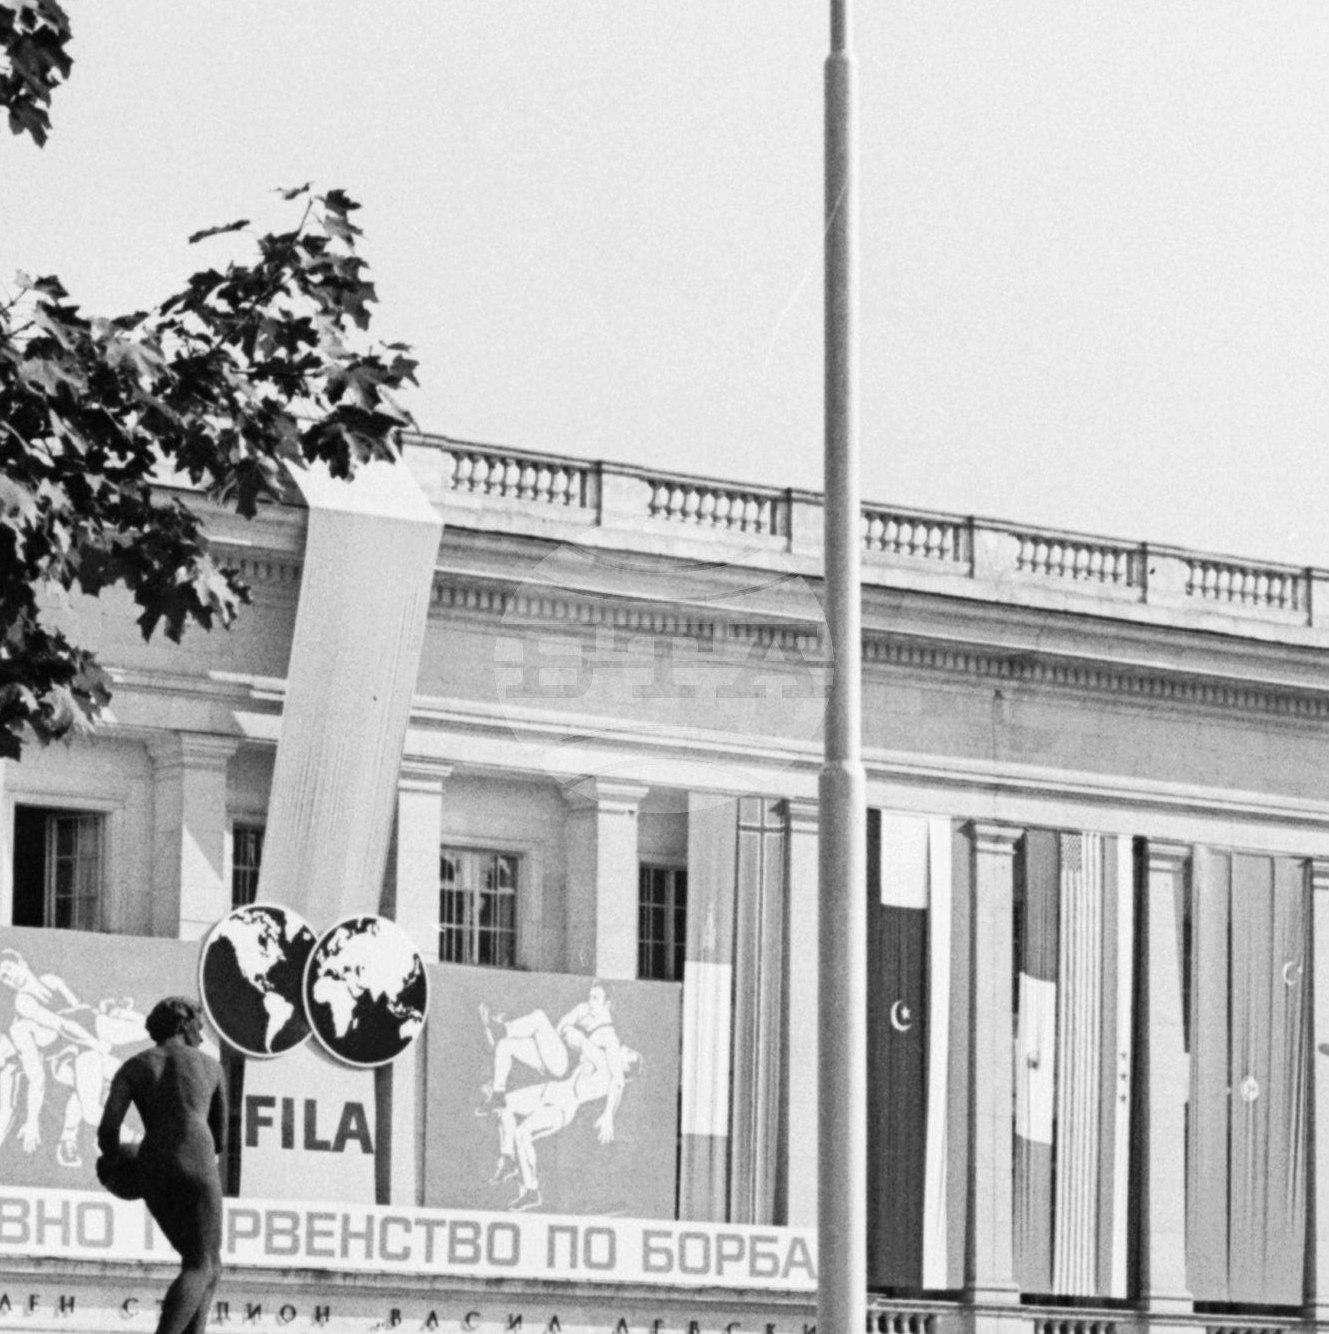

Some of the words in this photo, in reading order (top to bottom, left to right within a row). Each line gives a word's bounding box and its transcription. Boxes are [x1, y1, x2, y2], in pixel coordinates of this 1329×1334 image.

[244, 1094, 375, 1155] FILA
[144, 1206, 521, 1268] РВЕНСТВО
[546, 1223, 618, 1270] ПО
[641, 1229, 818, 1280] БОРБА
[122, 1297, 331, 1326] СДИОН
